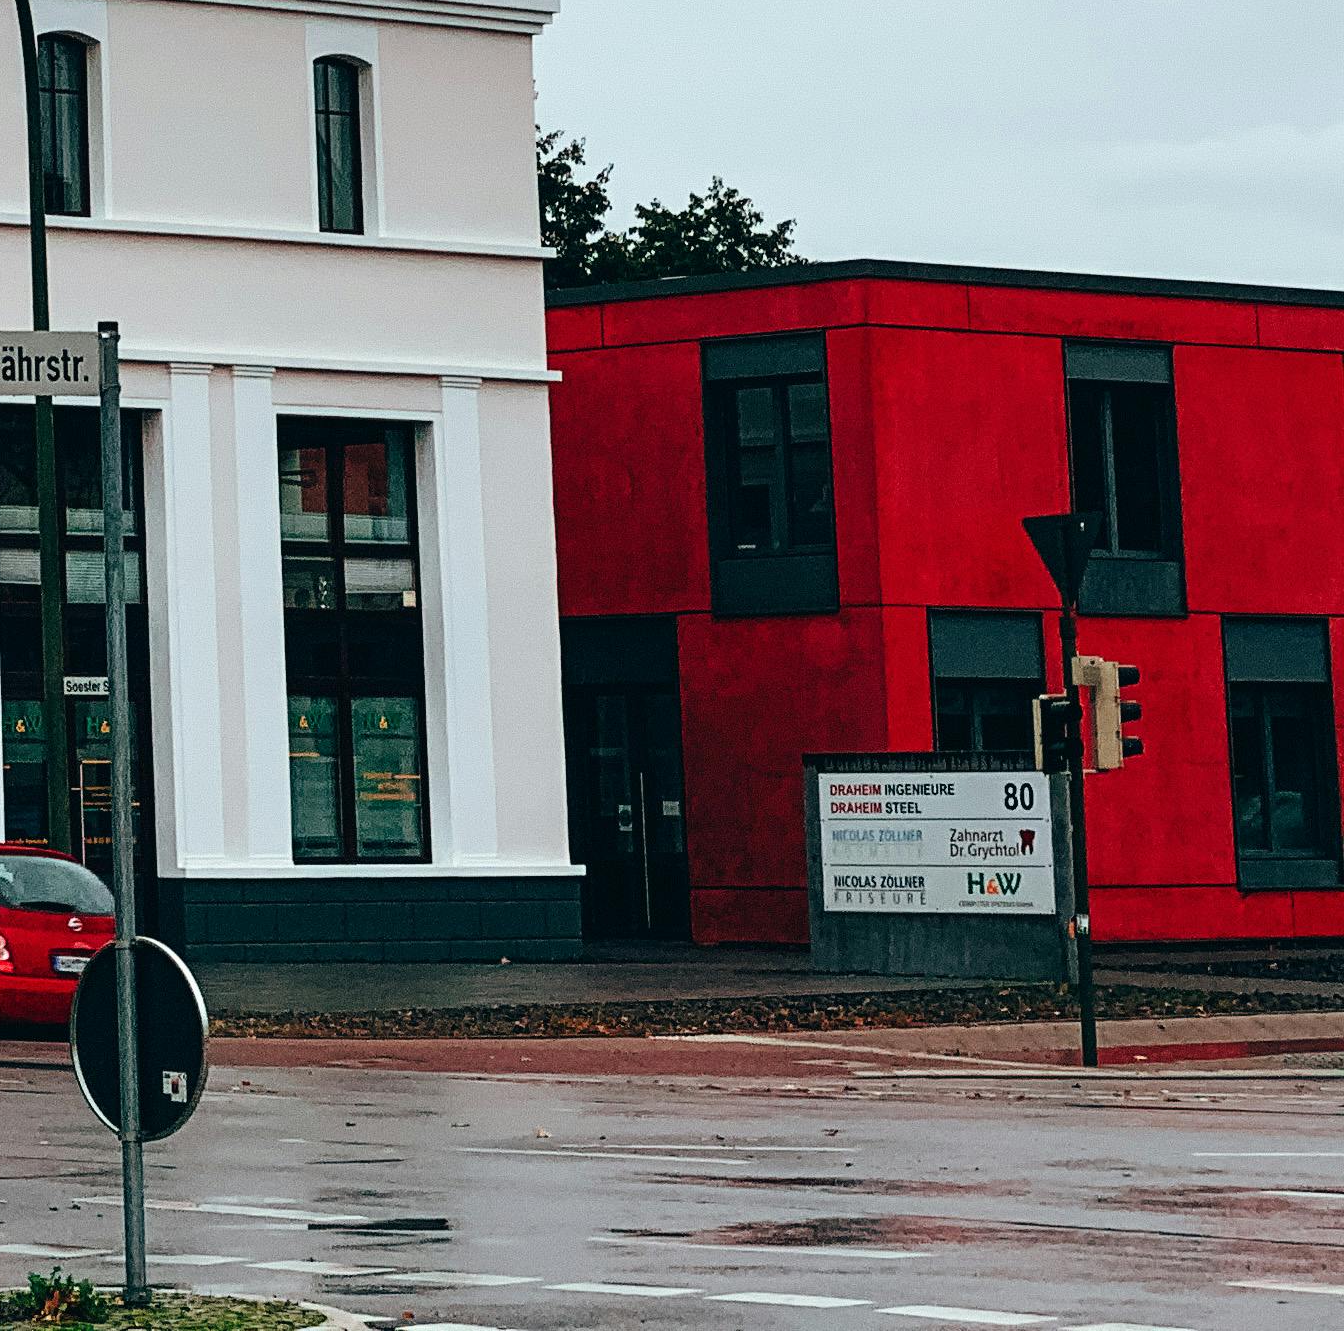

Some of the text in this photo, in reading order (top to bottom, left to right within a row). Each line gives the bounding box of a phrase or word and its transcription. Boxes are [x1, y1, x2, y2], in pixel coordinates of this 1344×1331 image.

[66, 680, 100, 692] Soester
[830, 783, 955, 796] DRAHEIM INGENIEURE
[1004, 782, 1034, 810] 80
[831, 802, 922, 814] DRAHEIM STEEL
[833, 828, 923, 842] NICOLAS ZÖLLNER
[949, 828, 1003, 842] Zahnarzt
[967, 842, 1019, 860] Grychtol
[834, 874, 925, 888] NICOLAS ZÖLLNER
[967, 872, 1022, 895] H&W
[834, 892, 927, 905] FRISEURE
